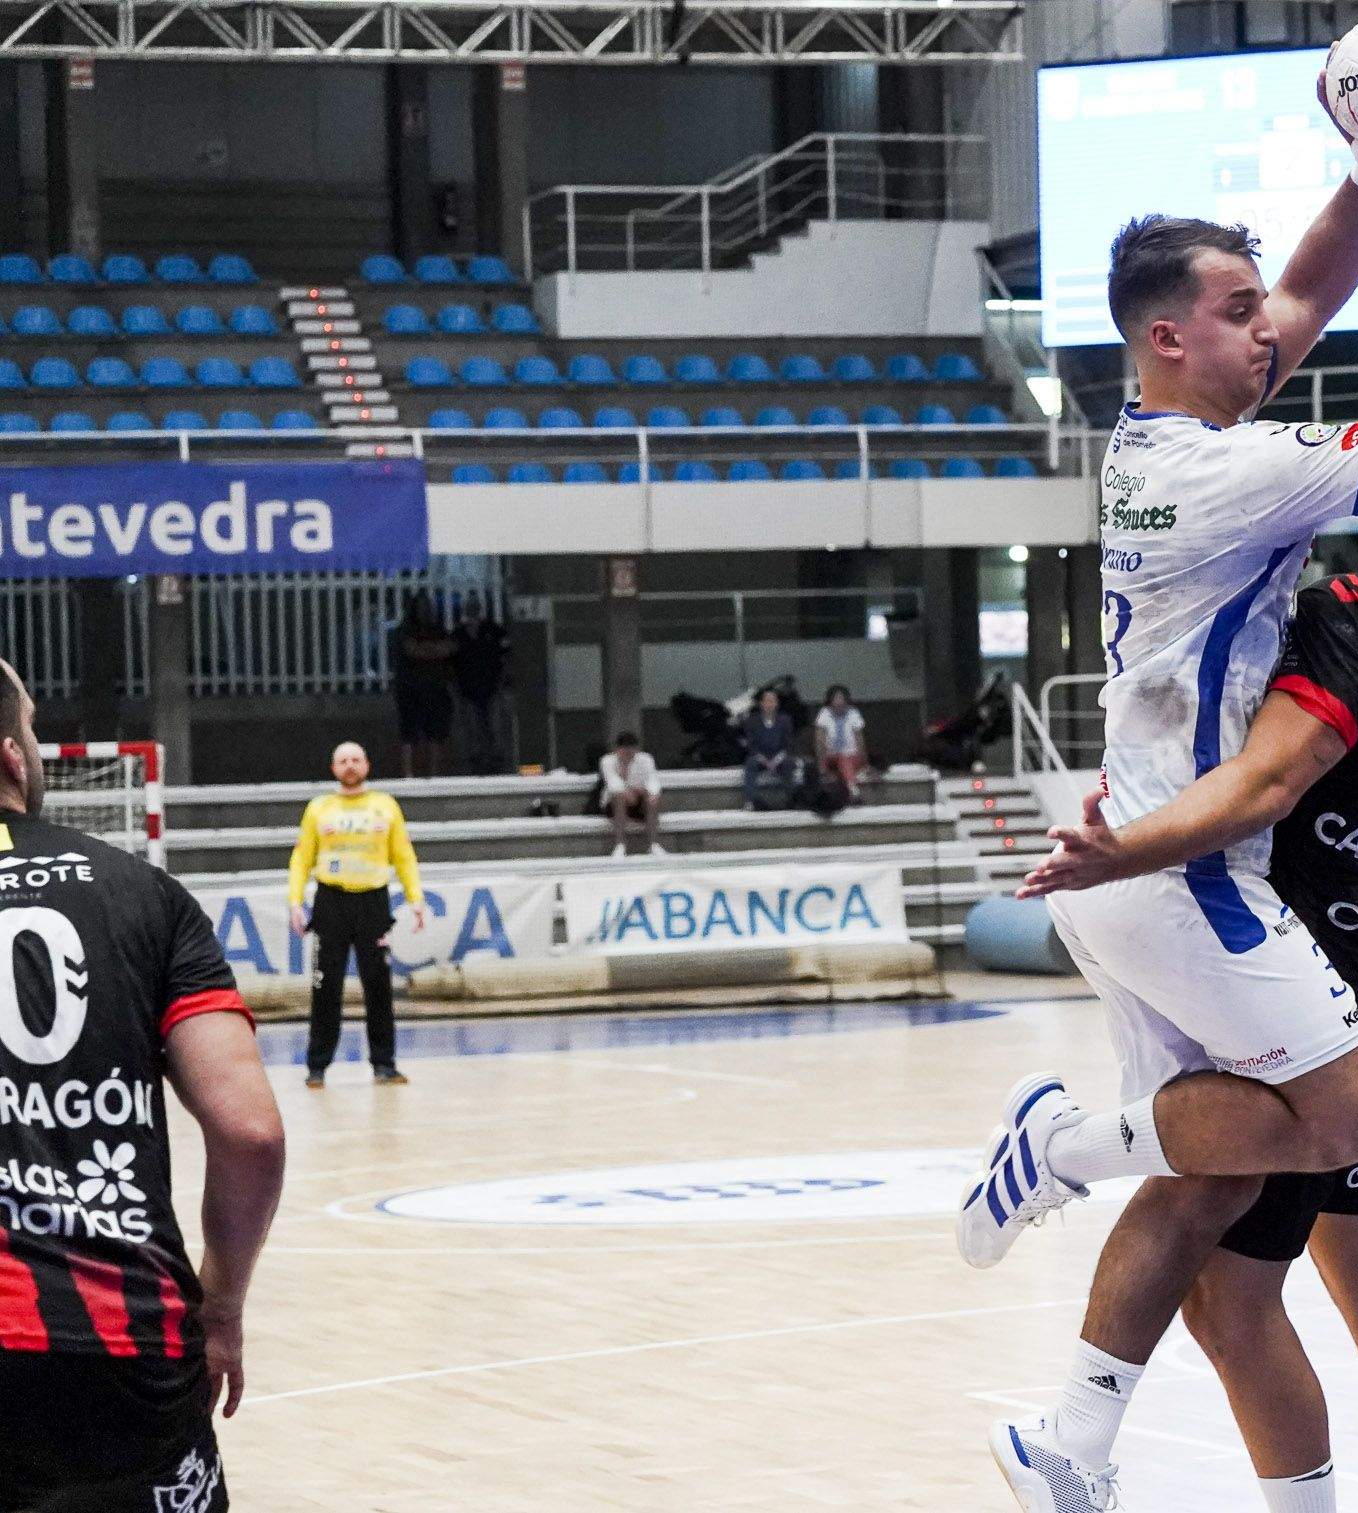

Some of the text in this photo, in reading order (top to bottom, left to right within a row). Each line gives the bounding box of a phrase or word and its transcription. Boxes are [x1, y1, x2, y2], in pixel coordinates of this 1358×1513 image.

[1105, 465, 1146, 497] Colegio
[0, 481, 333, 557] tevedra
[1112, 498, 1178, 531] Sauces
[616, 883, 880, 942] ABANCA
